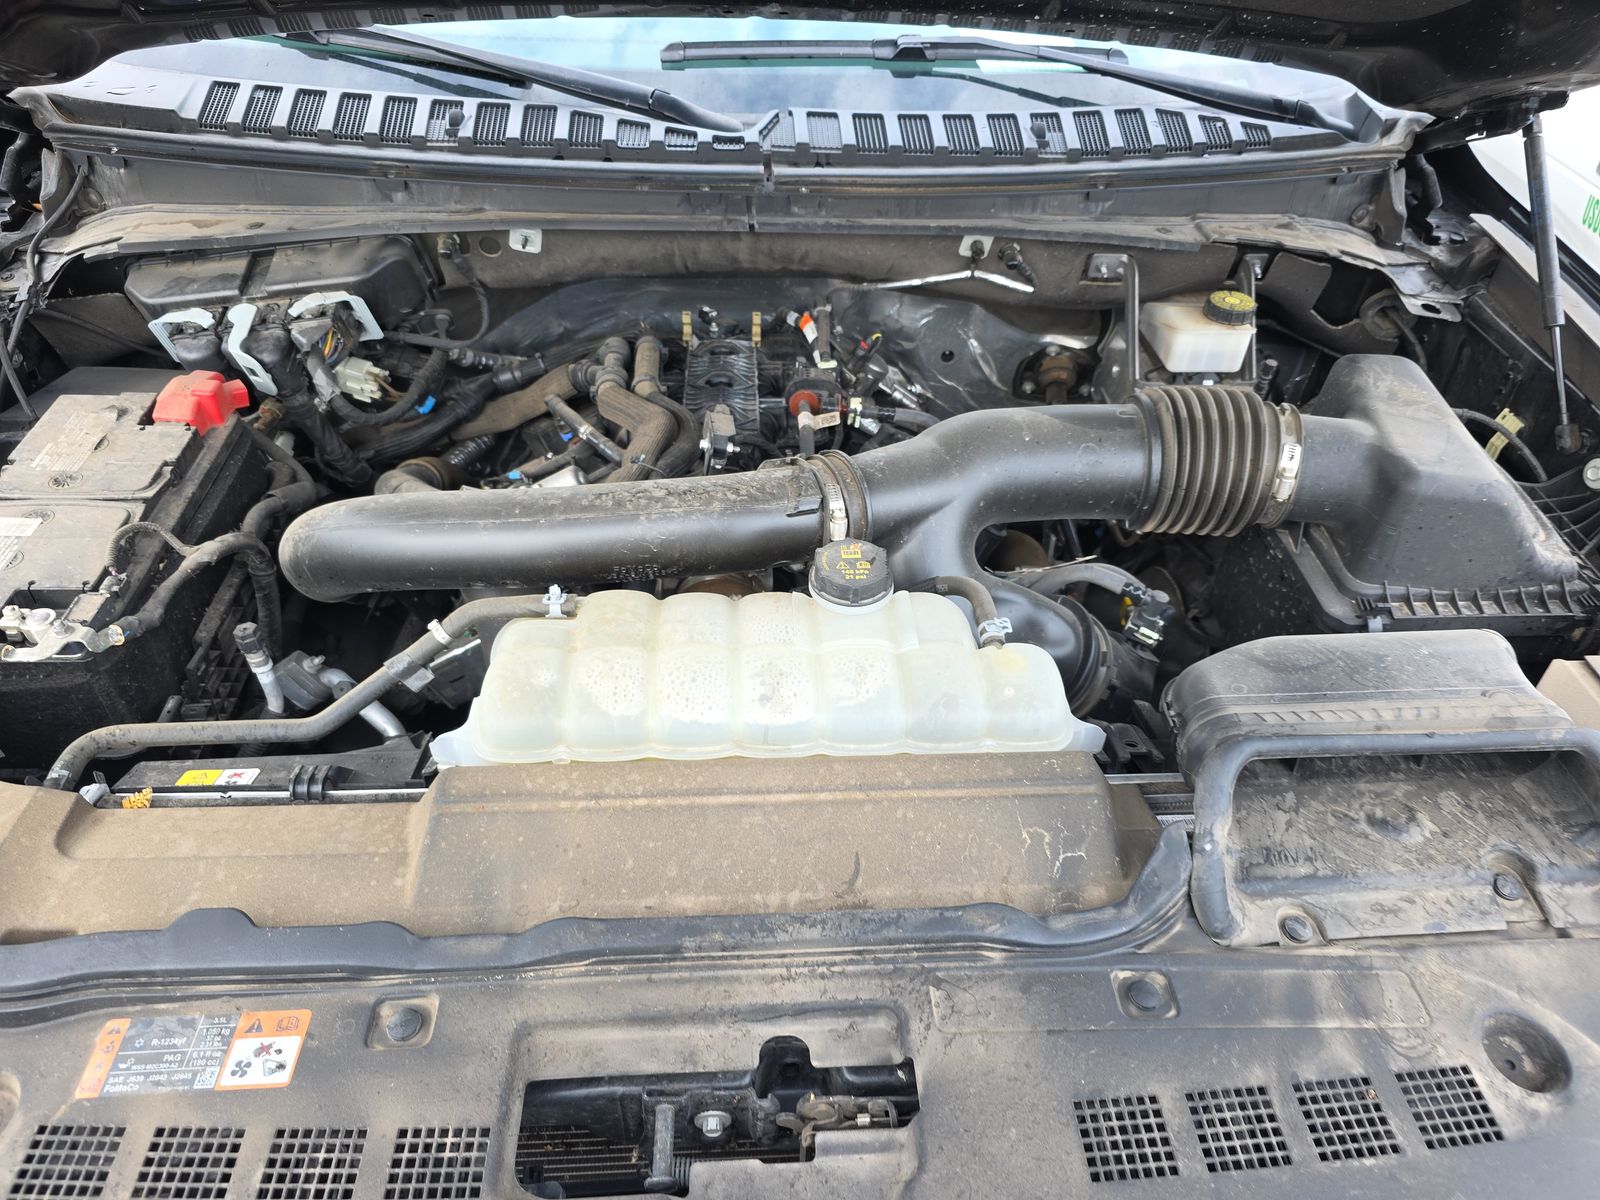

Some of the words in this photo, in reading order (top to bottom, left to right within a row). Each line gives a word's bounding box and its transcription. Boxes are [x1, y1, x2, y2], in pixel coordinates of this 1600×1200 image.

[221, 1028, 231, 1036] kg
[151, 1037, 187, 1048] R-1234yf
[163, 1054, 182, 1062] PAG
[207, 1058, 220, 1066] cc)
[104, 1084, 140, 1093] FoMoCo
